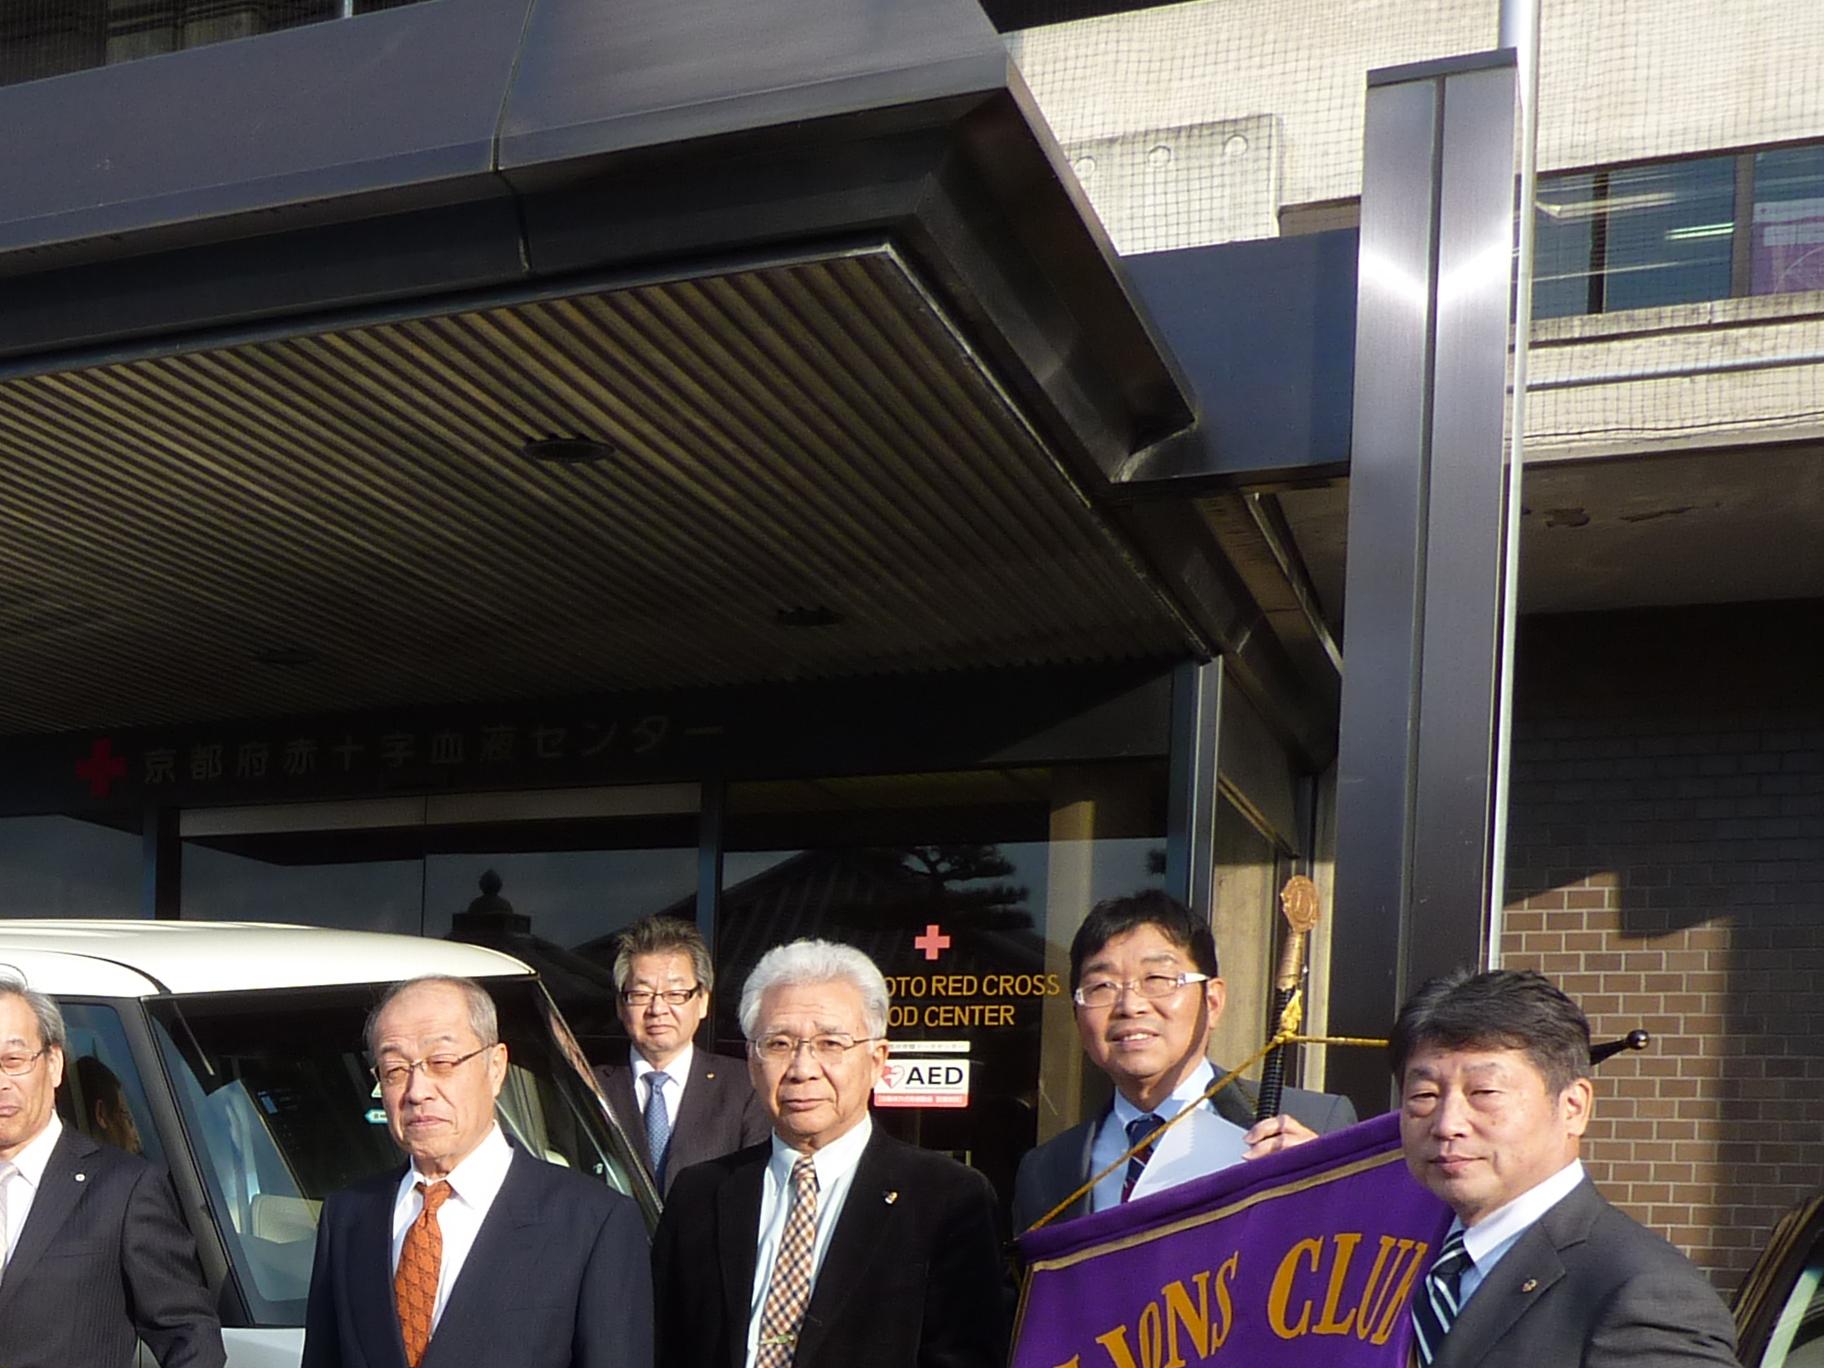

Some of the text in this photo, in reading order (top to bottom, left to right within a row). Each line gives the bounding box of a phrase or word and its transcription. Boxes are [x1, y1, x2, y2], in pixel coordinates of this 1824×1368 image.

[142, 713, 725, 786] 京都府赤十字血液センター
[885, 975, 1060, 997] OTO RED CROSS
[924, 1005, 1015, 1027] CENTER
[906, 1067, 963, 1085] AED
